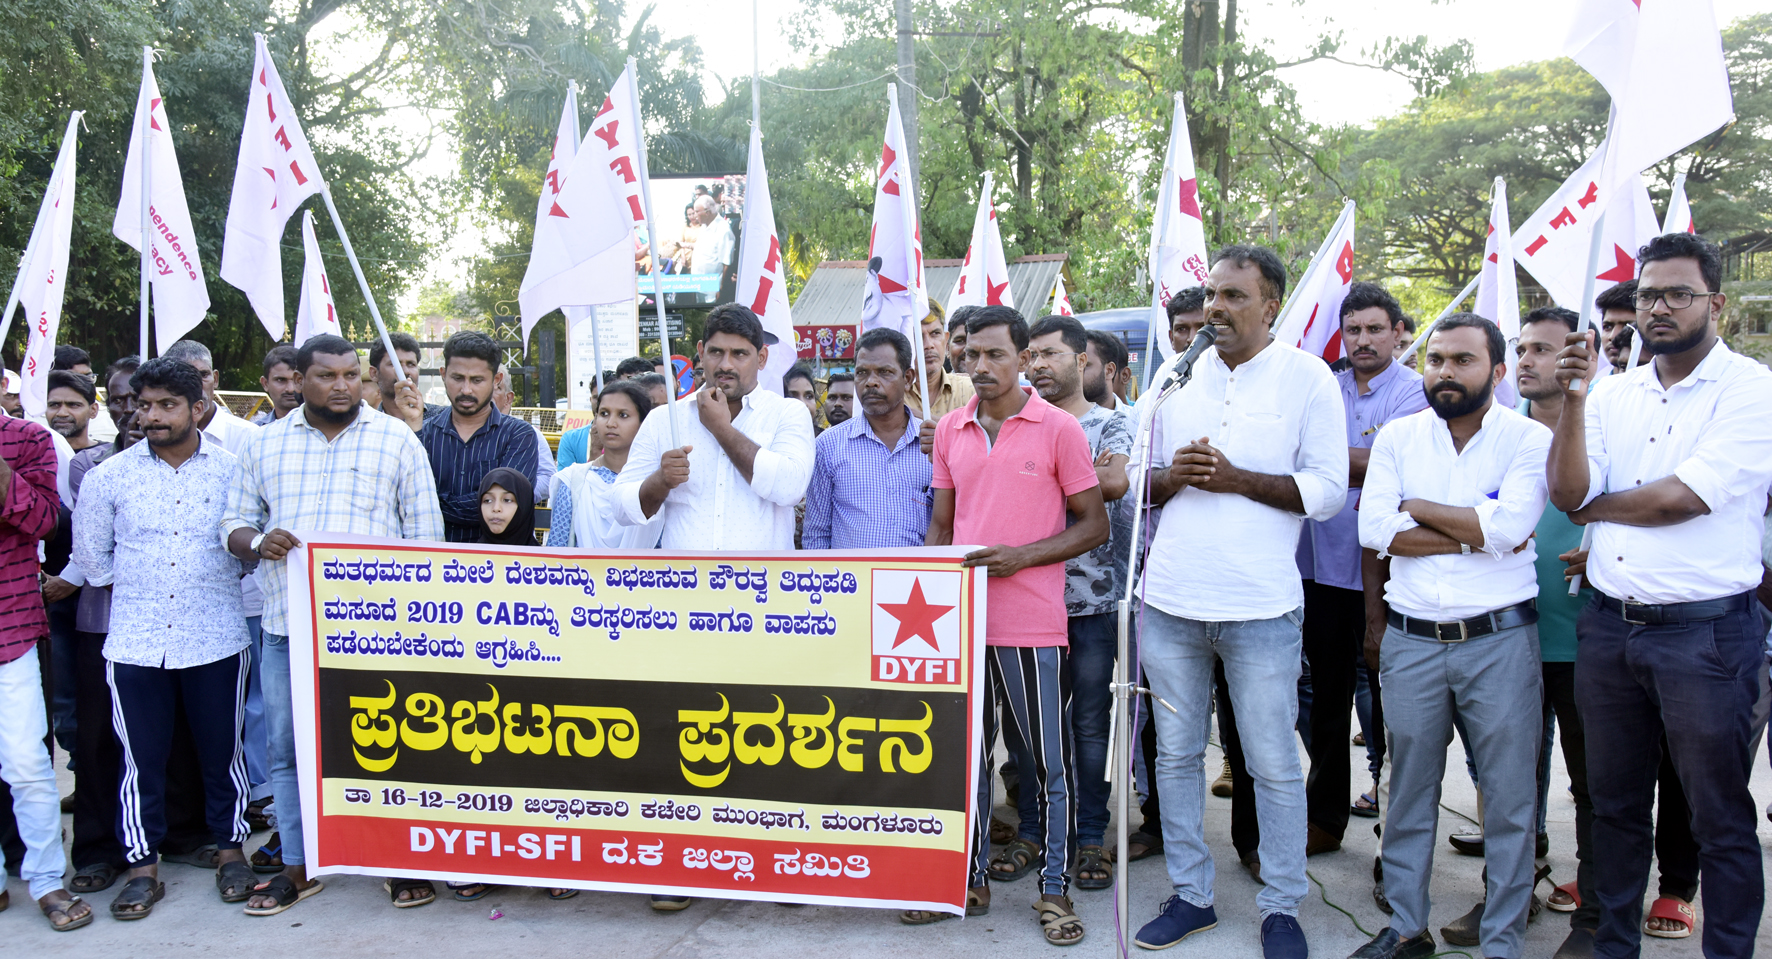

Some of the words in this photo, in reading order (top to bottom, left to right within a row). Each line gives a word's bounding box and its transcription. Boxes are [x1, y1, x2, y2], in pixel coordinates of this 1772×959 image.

[323, 556, 432, 586] ಮತಧರ್ಮದ
[443, 559, 495, 585] ಮೇಲೆ
[505, 562, 596, 597] ದೇಶವನ್ನು
[606, 565, 698, 593] ವಿಭಜಿಸುವ
[709, 564, 768, 604] ಪೌರತ್ವ
[779, 567, 858, 605] ತಿದ್ದುಪಡಿ
[324, 596, 397, 622] ಮಸೂದೆ
[407, 601, 464, 624] 2019
[476, 601, 561, 637] CABನ್ನು
[570, 604, 678, 640] ತಿರಸ್ಕರಿಸಲು
[689, 607, 753, 633] ಹಾಗೂ
[765, 610, 837, 635] ವಾಪಸು
[326, 630, 465, 659] ಪಡೆಯಬೇಕೆಂದು
[879, 657, 956, 682] DYFI
[349, 679, 640, 772] ಪ್ರತಿಭಟನಾ
[678, 691, 934, 788] ಪ್ರದರ್ಶನ
[345, 788, 371, 803] ತಾ
[381, 788, 513, 812] 16-12-2019
[524, 798, 629, 821] ಜಿಲ್ಲಾಧಿಕಾರಿ
[641, 799, 701, 821] ಕಚೇರಿ
[712, 807, 811, 831] ಮುಂಭಾಗ,
[821, 811, 944, 835] ಮಂಗಳೂರು
[410, 826, 582, 862] DYFI-SFI
[602, 837, 664, 866] ದ.ಕ
[682, 846, 756, 882] ಜಿಲ್ಲಾ
[773, 848, 871, 879] ಸಮಿತಿ
